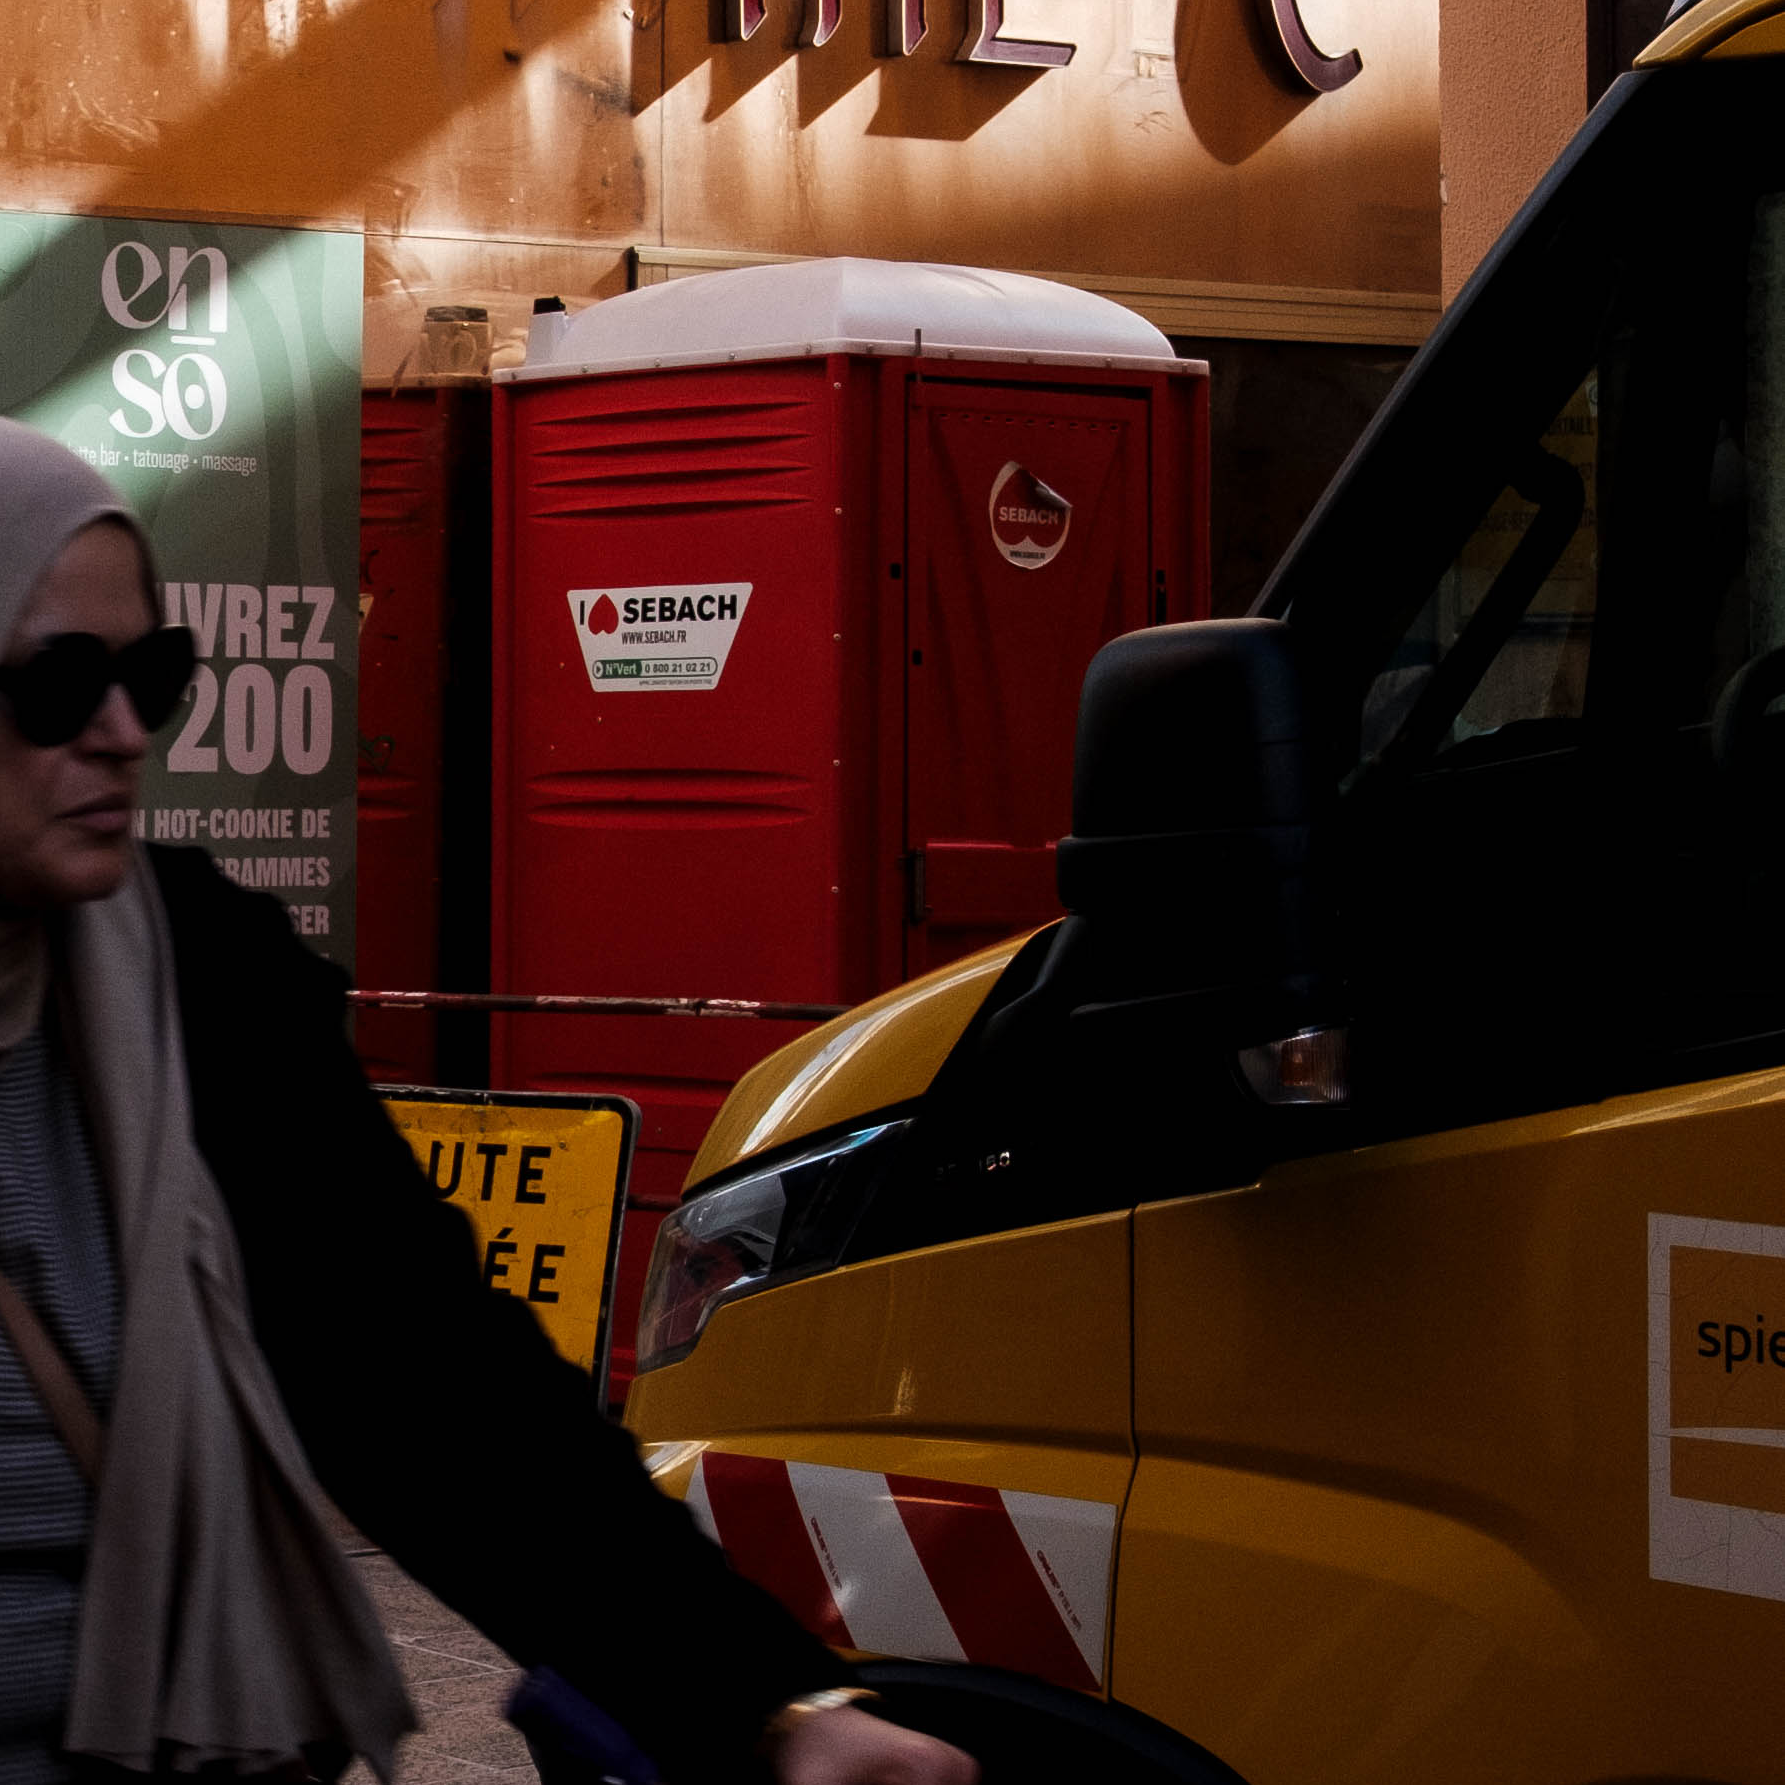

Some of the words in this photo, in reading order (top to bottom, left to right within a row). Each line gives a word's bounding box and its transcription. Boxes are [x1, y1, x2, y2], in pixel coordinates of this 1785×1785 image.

[100, 241, 228, 333] en
[100, 445, 121, 467] bar
[133, 448, 190, 474] tatouage
[201, 454, 258, 477] massage
[998, 506, 1059, 525] SEBACH
[162, 582, 335, 660] VREZ
[579, 600, 586, 626] I
[622, 594, 738, 624] SEBACH
[621, 629, 687, 645] WWW.SEBACH.FR
[644, 664, 651, 674] 0
[652, 663, 670, 674] 800
[671, 663, 683, 673] 21
[685, 662, 698, 673] 02
[699, 661, 712, 672] 21
[166, 663, 334, 775] 200
[153, 808, 294, 840] HOT-COOKIE
[301, 809, 331, 839] DE
[427, 1140, 553, 1205] UTE
[483, 1227, 567, 1305] ÉE
[1697, 1314, 1785, 1374] spie
